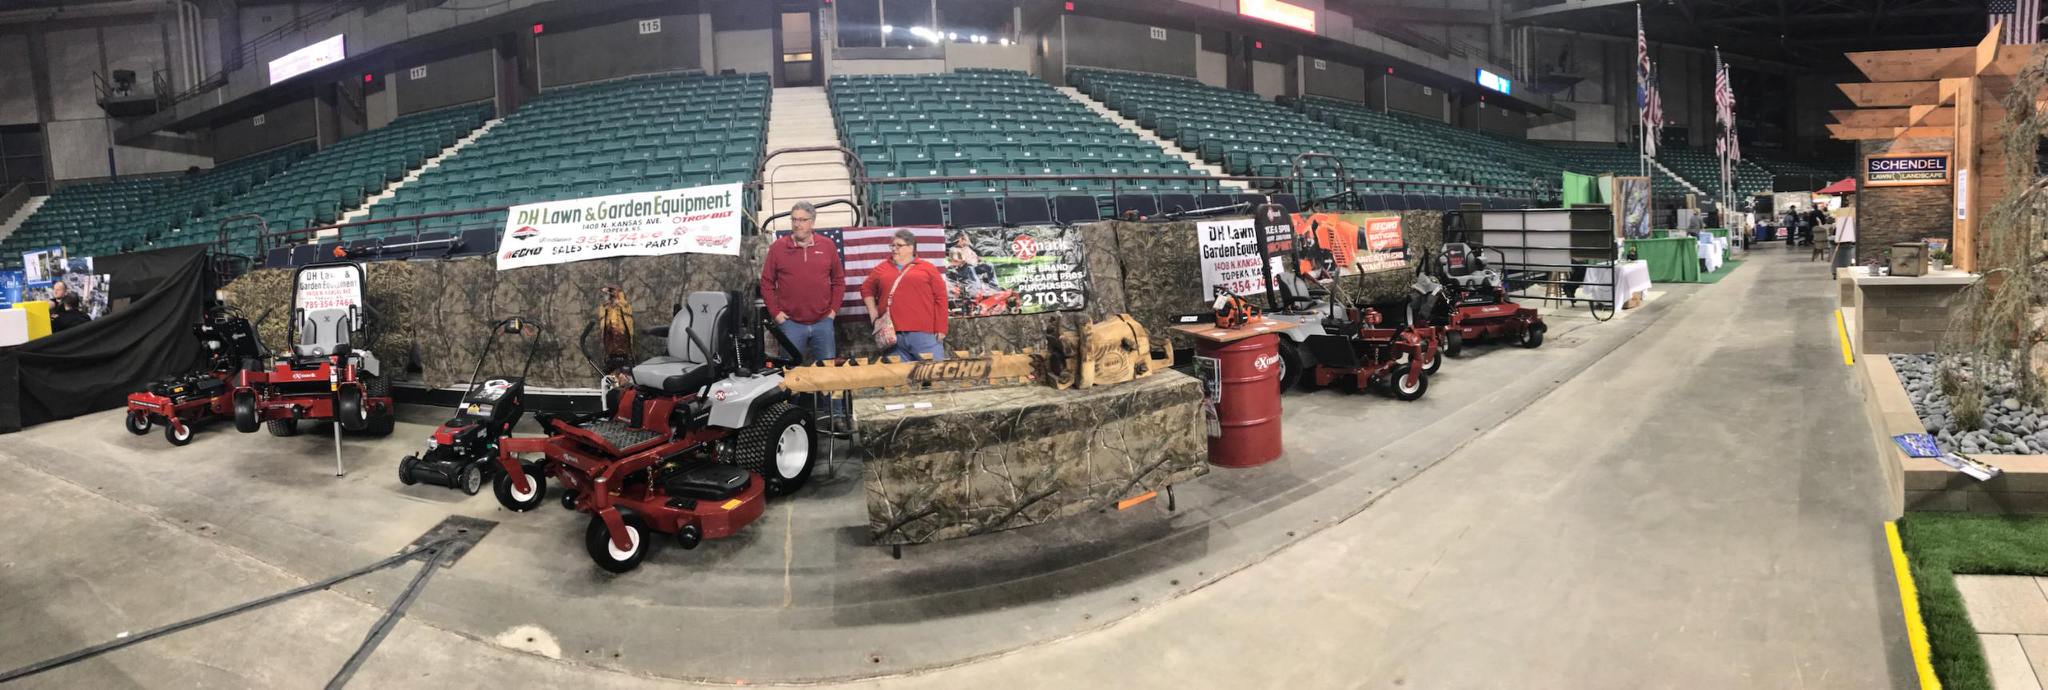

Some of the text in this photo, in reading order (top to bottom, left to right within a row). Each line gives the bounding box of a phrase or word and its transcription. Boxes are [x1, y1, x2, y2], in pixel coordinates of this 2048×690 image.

[641, 20, 659, 32] 115
[412, 67, 425, 79] 117
[1871, 159, 1944, 170] SCHENDEL
[517, 190, 732, 225] DH Lawn & Garden Equipment
[612, 219, 643, 228] KANSAS
[1208, 226, 1225, 241] DH
[1227, 225, 1255, 240] Lawn
[552, 244, 582, 256] SALES
[645, 237, 679, 248] PARTS
[1203, 244, 1236, 259] Garden
[1019, 263, 1068, 274] THE BRAND
[306, 271, 317, 281] DH
[1004, 271, 1083, 284] LANDSCAPE PROS
[1022, 293, 1033, 307] 2
[1035, 291, 1058, 305] TO
[929, 360, 986, 380] ECHO
